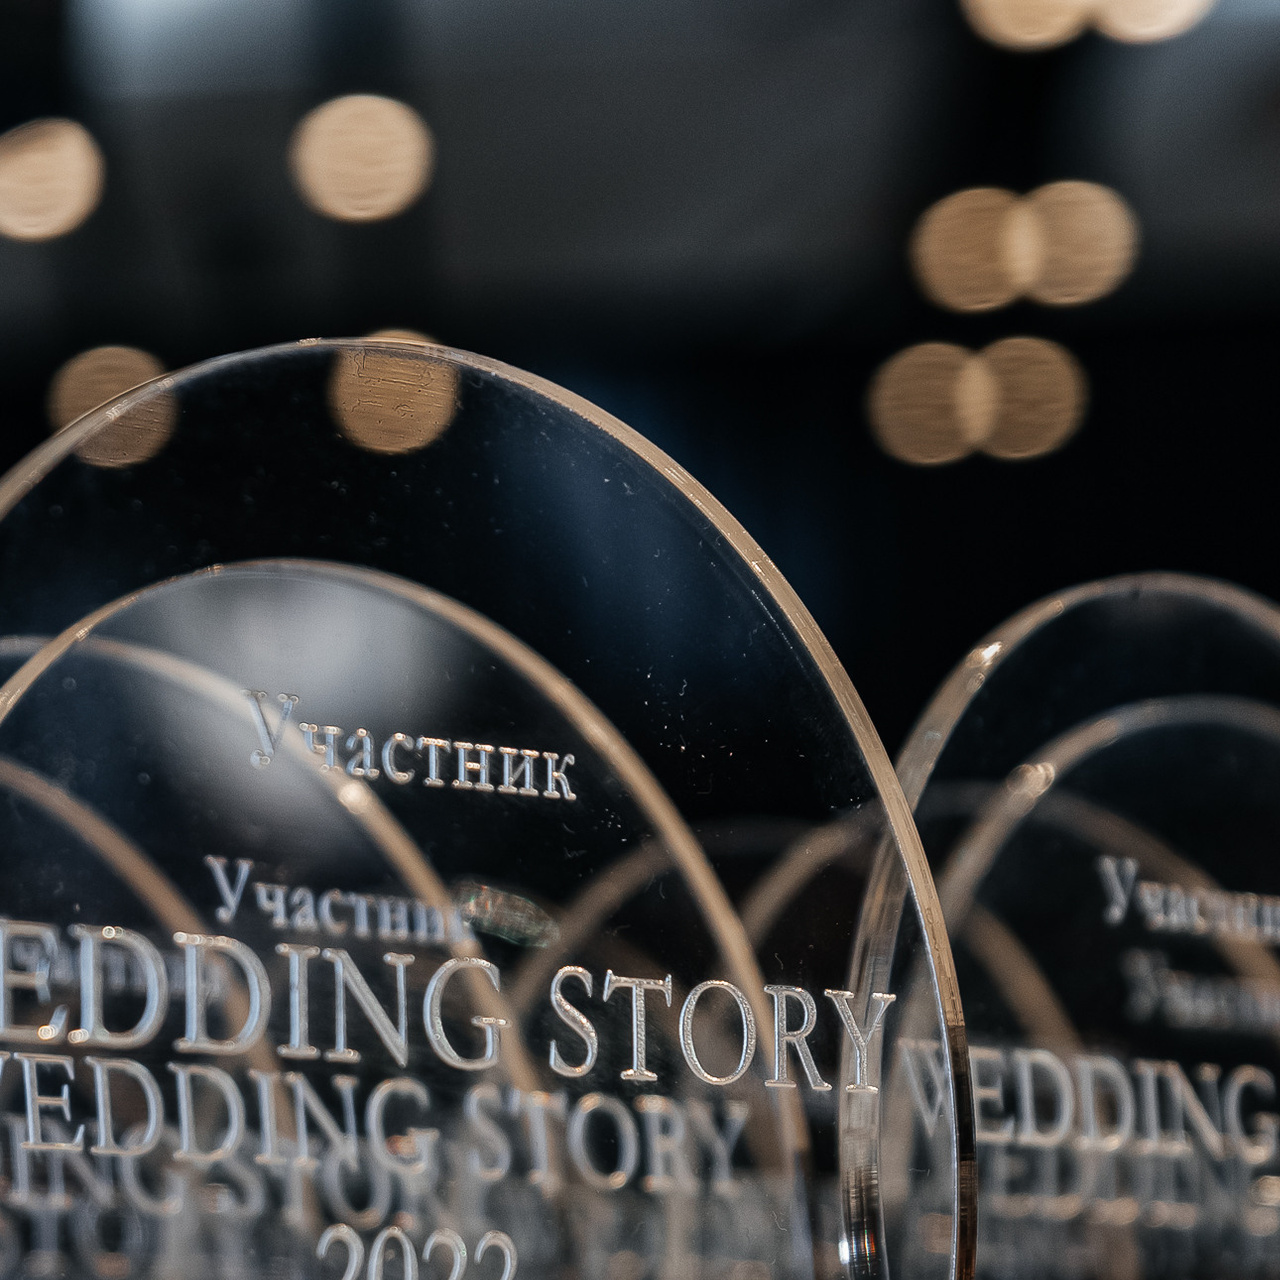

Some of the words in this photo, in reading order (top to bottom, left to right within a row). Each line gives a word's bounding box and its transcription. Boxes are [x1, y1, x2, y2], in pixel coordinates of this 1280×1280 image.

[240, 688, 577, 800] Участник
[548, 964, 897, 1094] STORY
[463, 1082, 750, 1198] STORY
